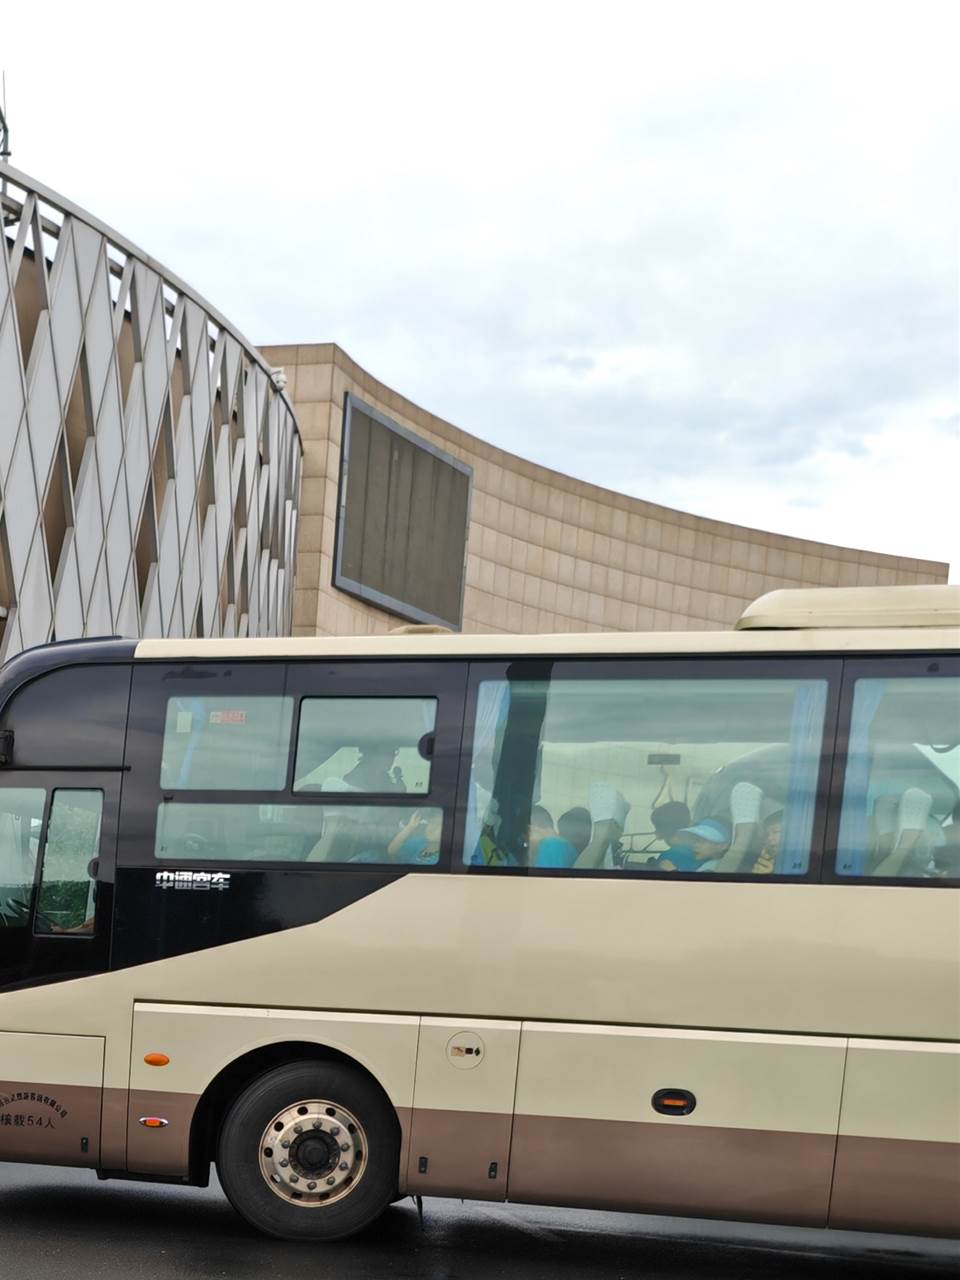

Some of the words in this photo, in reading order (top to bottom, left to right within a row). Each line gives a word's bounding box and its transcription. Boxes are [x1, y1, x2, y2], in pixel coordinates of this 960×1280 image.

[155, 871, 231, 890] 中通客车
[0, 1113, 56, 1129] 核载54人
